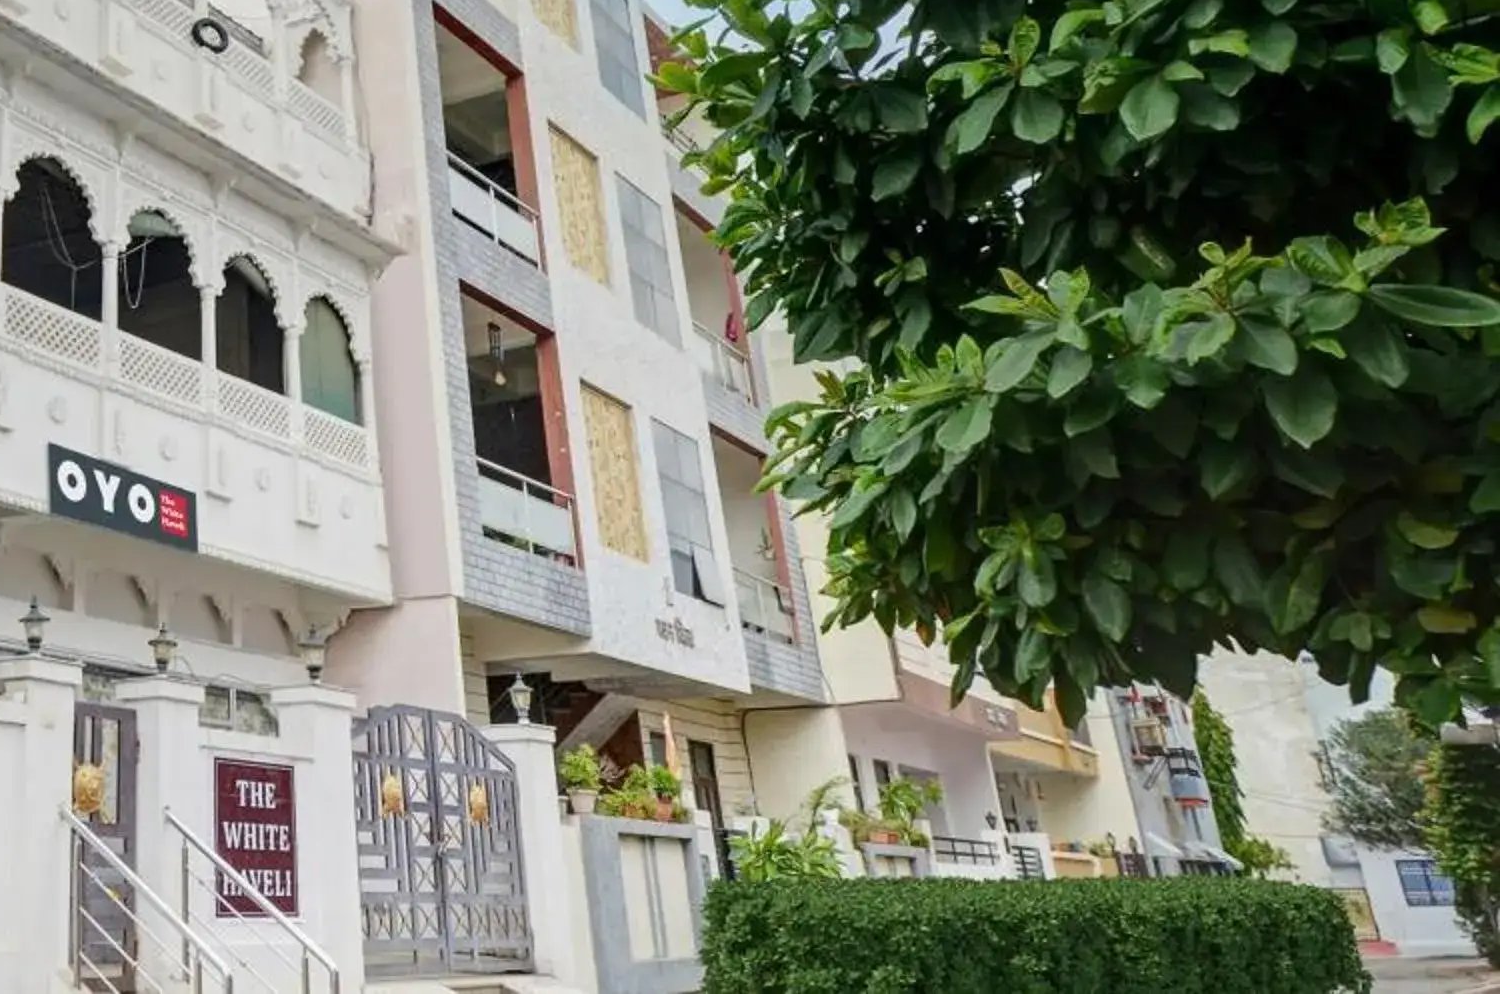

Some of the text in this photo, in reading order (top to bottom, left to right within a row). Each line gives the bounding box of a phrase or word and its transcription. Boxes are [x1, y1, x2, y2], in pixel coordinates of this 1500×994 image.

[57, 459, 156, 524] OYO
[235, 779, 276, 809] THE
[222, 821, 290, 851] WHITE
